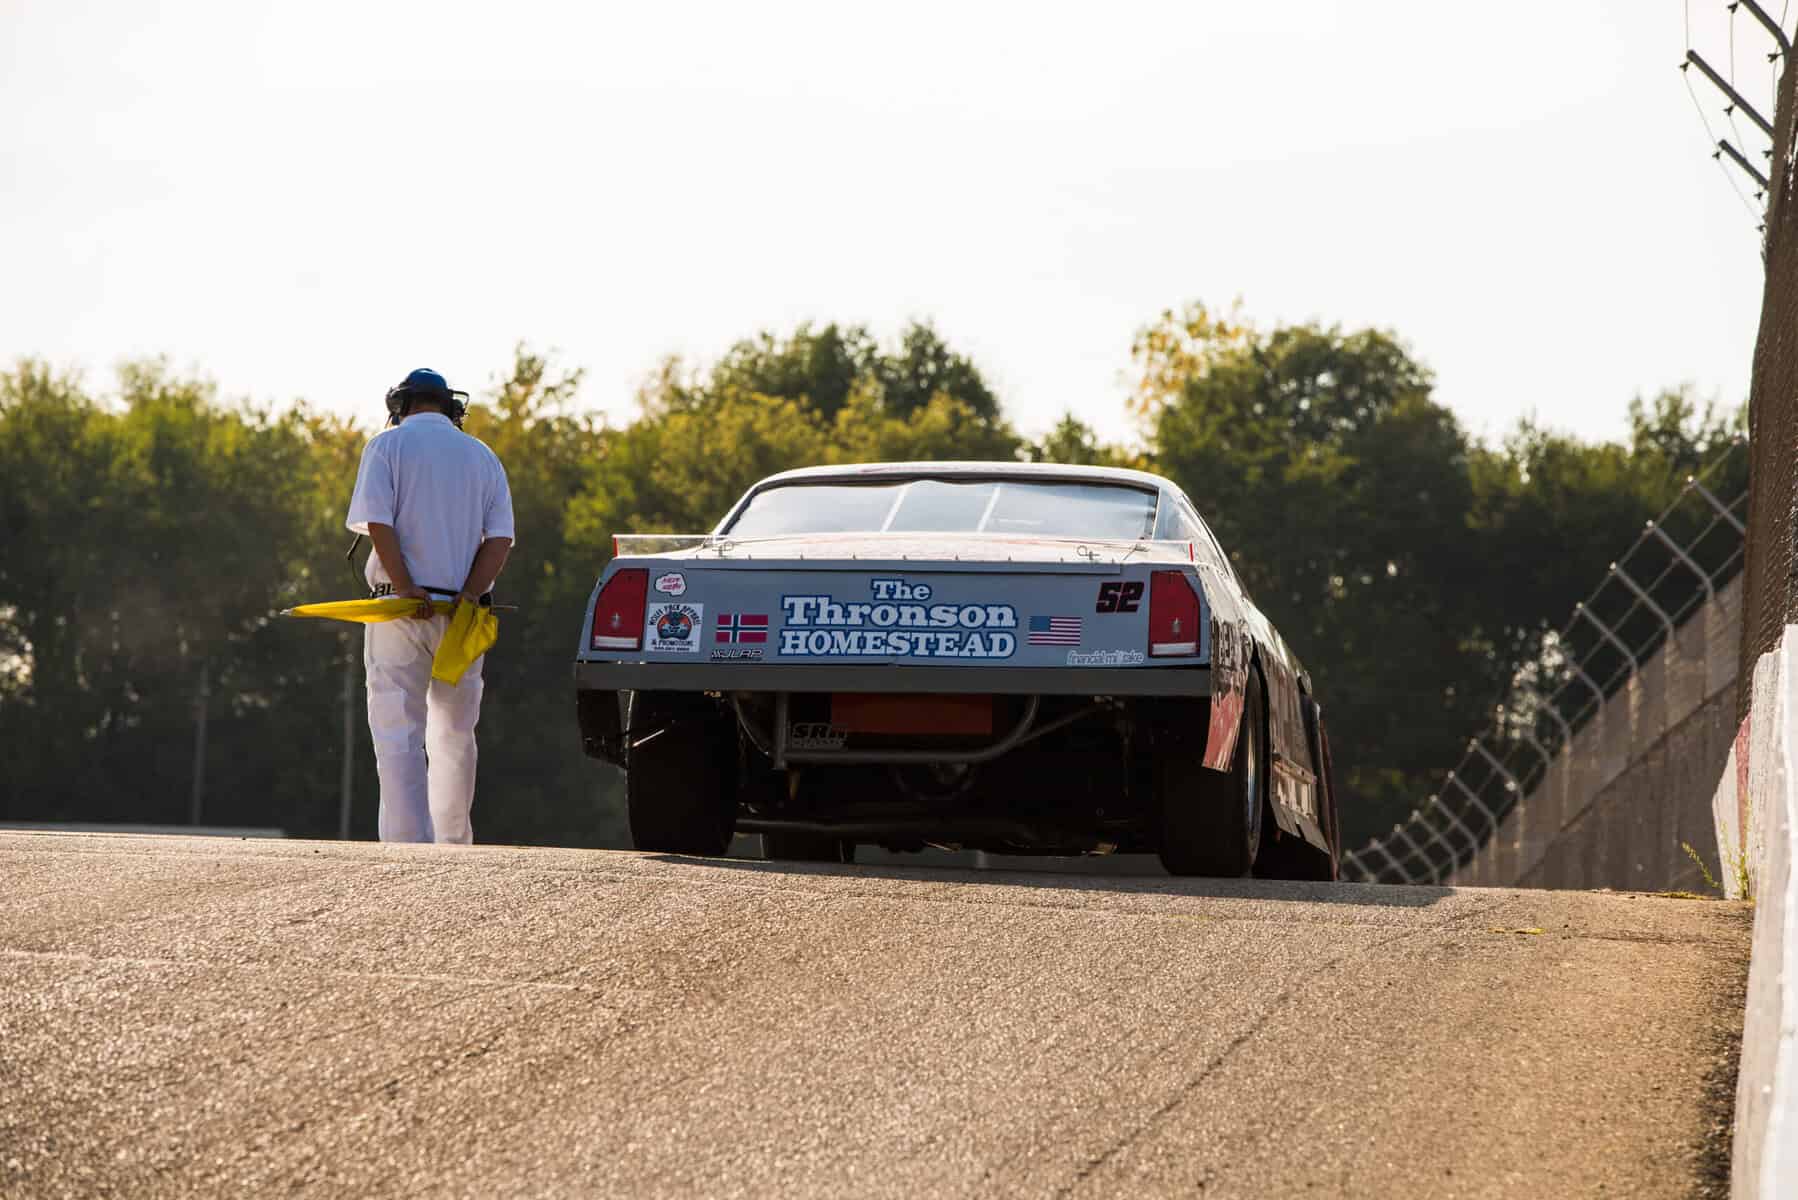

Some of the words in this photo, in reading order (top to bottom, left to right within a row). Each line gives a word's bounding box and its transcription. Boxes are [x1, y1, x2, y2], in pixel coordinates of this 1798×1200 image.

[872, 579, 931, 600] The
[1096, 582, 1144, 613] 52
[783, 596, 1016, 627] Thronson
[779, 630, 1016, 657] HOMESTEAD
